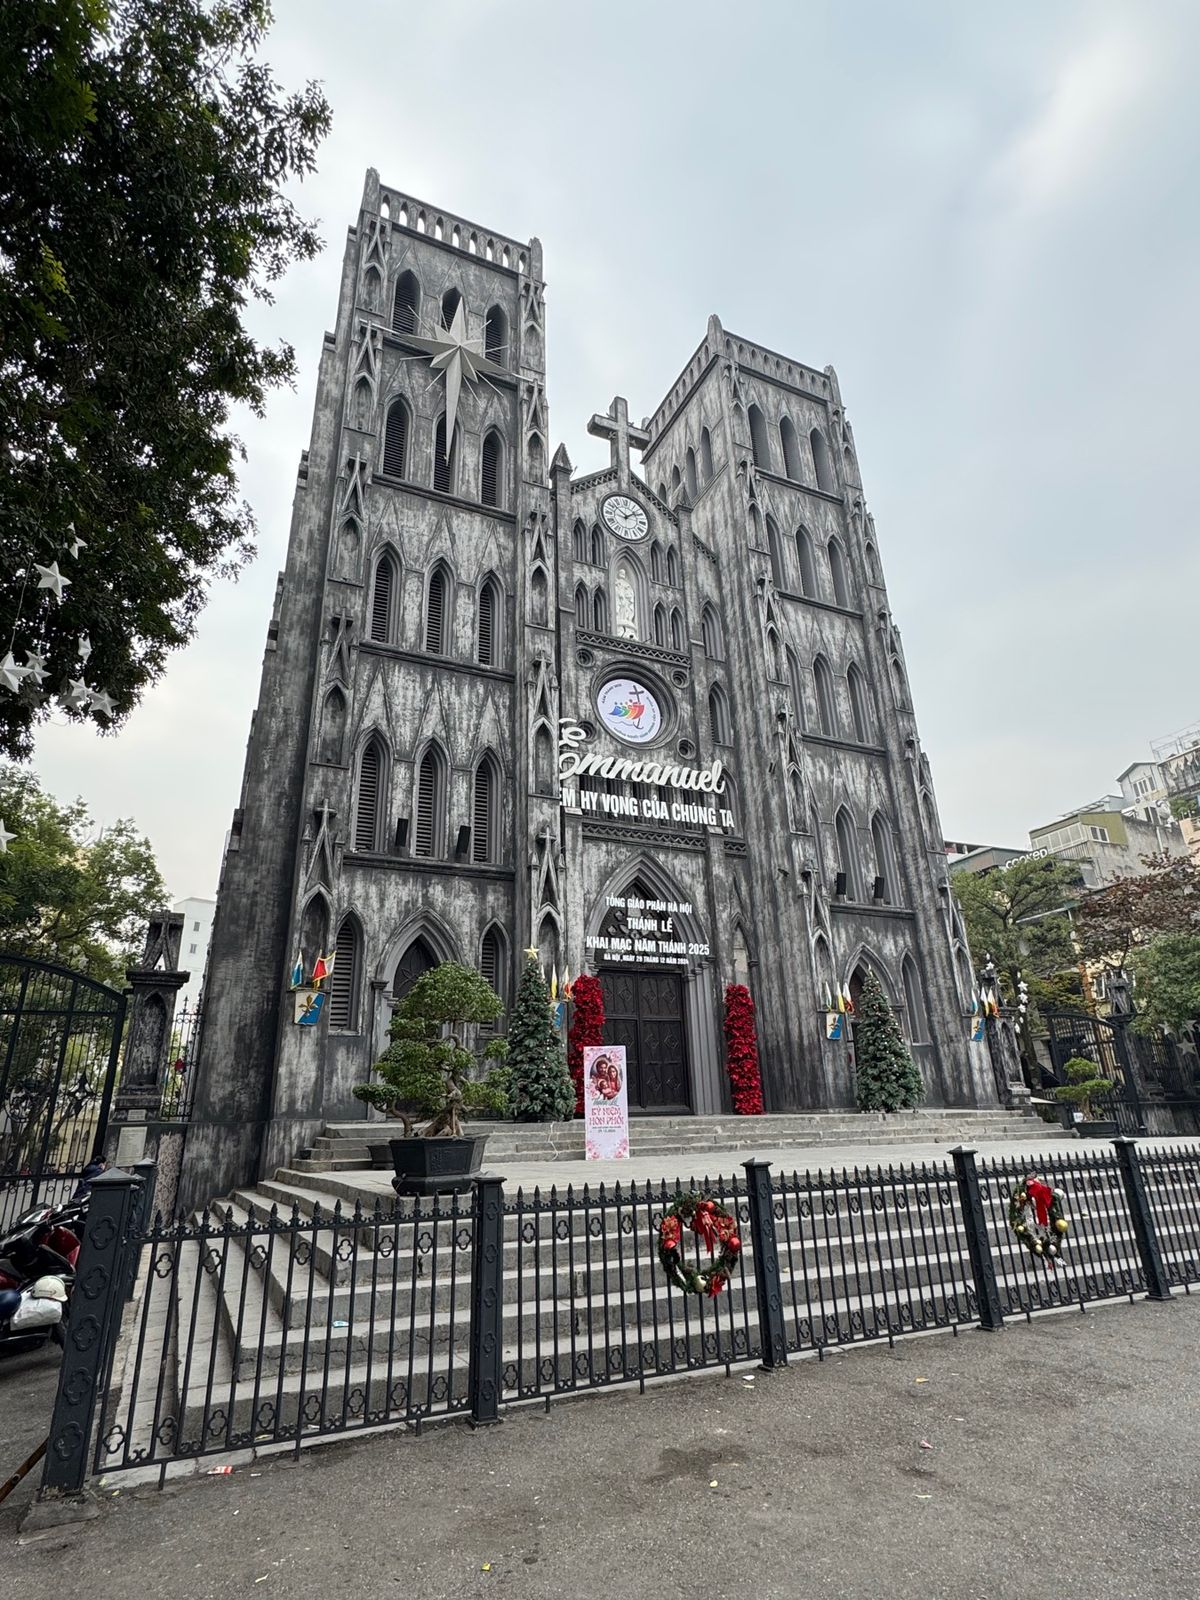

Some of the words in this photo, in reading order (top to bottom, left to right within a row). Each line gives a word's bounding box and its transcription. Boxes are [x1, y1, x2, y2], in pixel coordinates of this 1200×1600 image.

[580, 790, 598, 811] HY
[602, 793, 639, 818] VỌNG
[642, 794, 670, 820] CỦA
[672, 802, 717, 826] CHÚNG
[719, 809, 735, 828] TA
[606, 893, 625, 907] TỔNG
[627, 897, 644, 909] GIÁO
[646, 898, 666, 913] PHẬN
[667, 900, 678, 912] HÀ
[680, 902, 692, 915] NỘI
[627, 917, 658, 931] THÁNH
[661, 917, 673, 932] LỄ
[586, 936, 609, 950] KHAI
[611, 938, 632, 952] MẠC
[634, 938, 656, 952] NĂM
[658, 939, 687, 954] THÁNH
[688, 943, 710, 956] 2025
